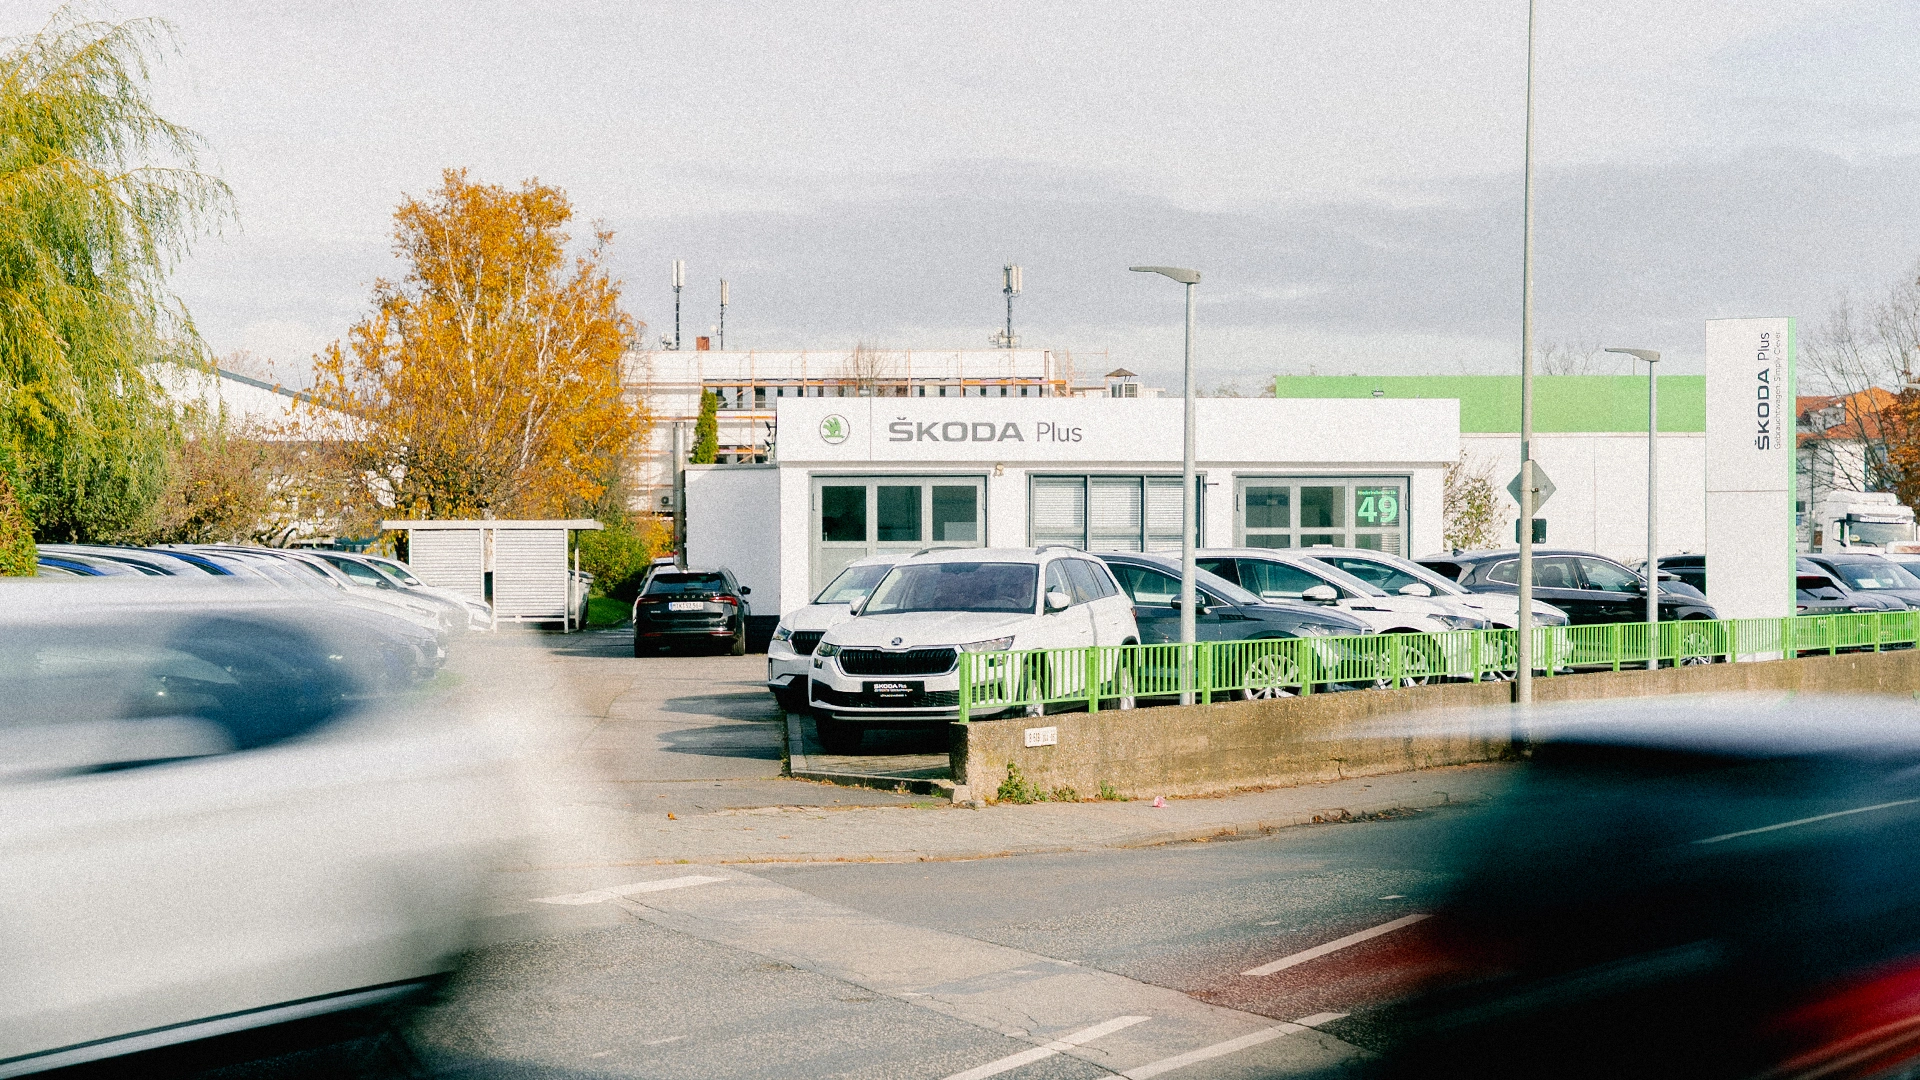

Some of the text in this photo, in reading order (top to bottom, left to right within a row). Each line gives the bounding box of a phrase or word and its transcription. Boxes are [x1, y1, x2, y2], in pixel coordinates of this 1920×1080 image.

[1754, 332, 1770, 450] ŠKODA Plus
[888, 416, 1083, 442] ŠKODA Plus
[1357, 496, 1398, 523] 49
